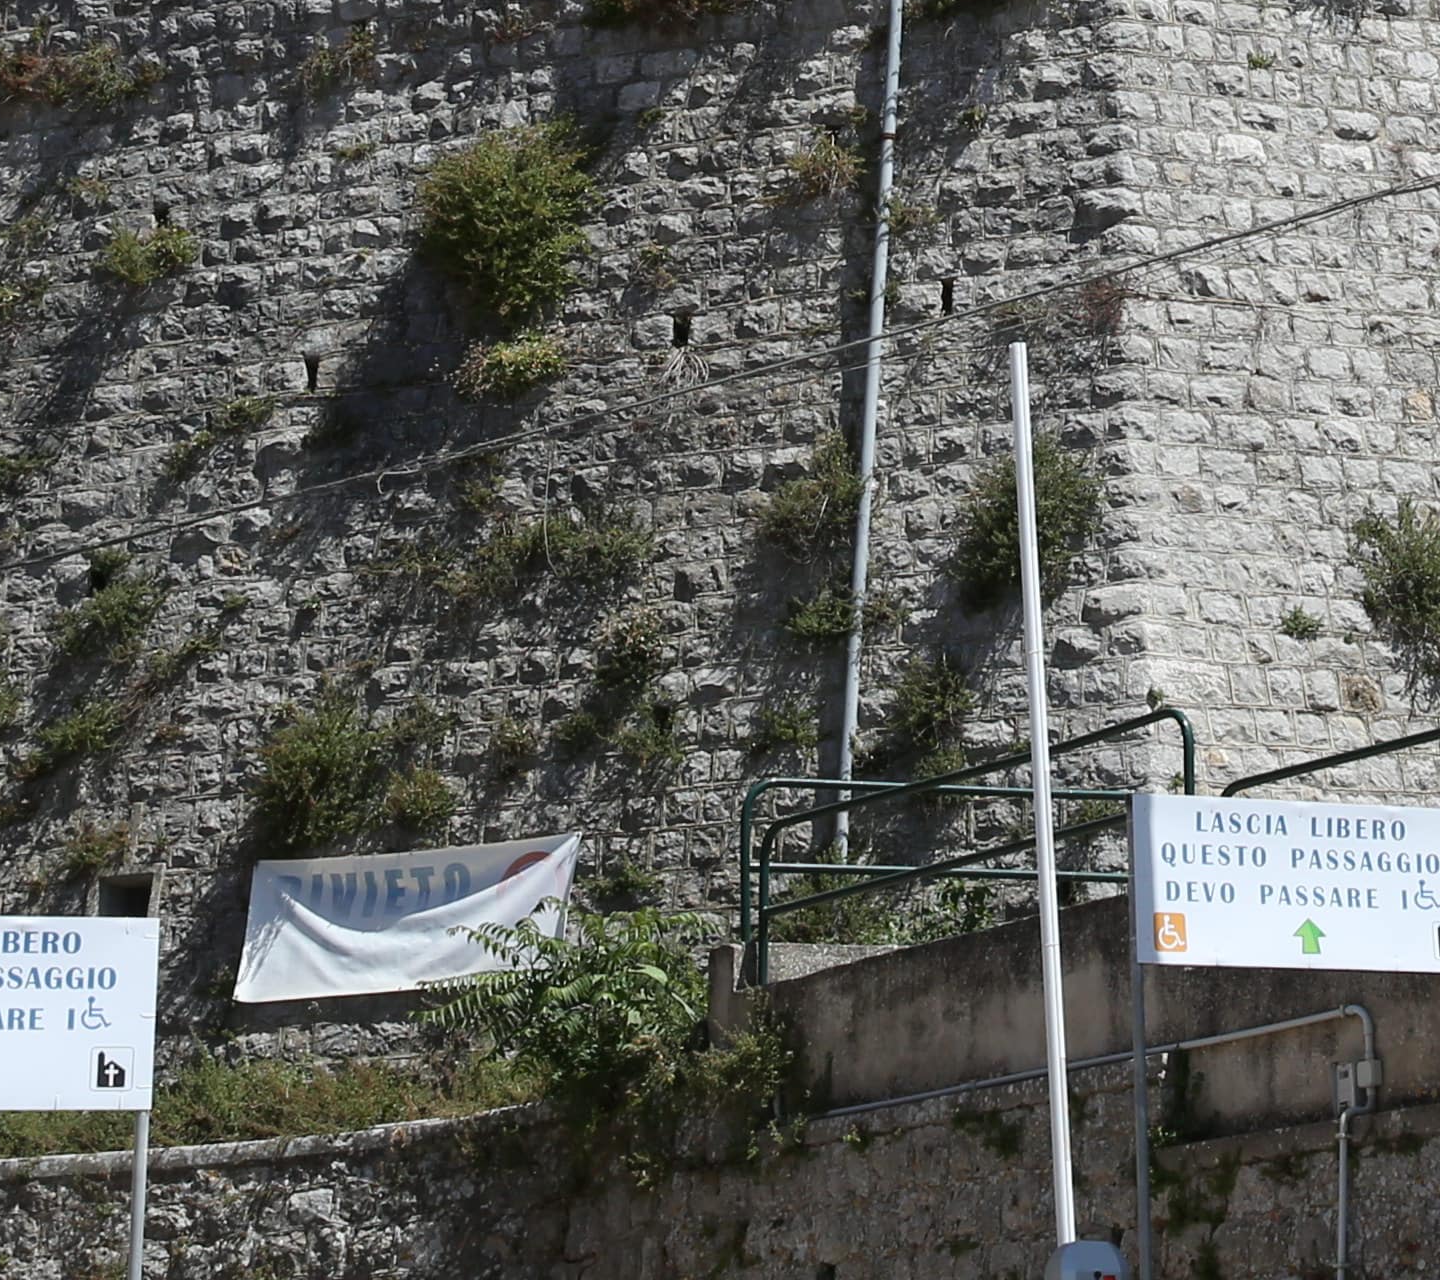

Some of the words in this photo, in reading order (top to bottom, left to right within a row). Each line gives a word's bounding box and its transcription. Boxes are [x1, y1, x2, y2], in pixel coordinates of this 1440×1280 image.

[1194, 810, 1289, 837] LASCIA
[1309, 816, 1407, 841] LIBERO
[1160, 842, 1267, 868] QUESTO
[1290, 847, 1440, 875] PASSAGGIO
[1165, 880, 1236, 904] DEVO
[1259, 884, 1380, 910] PASSARE
